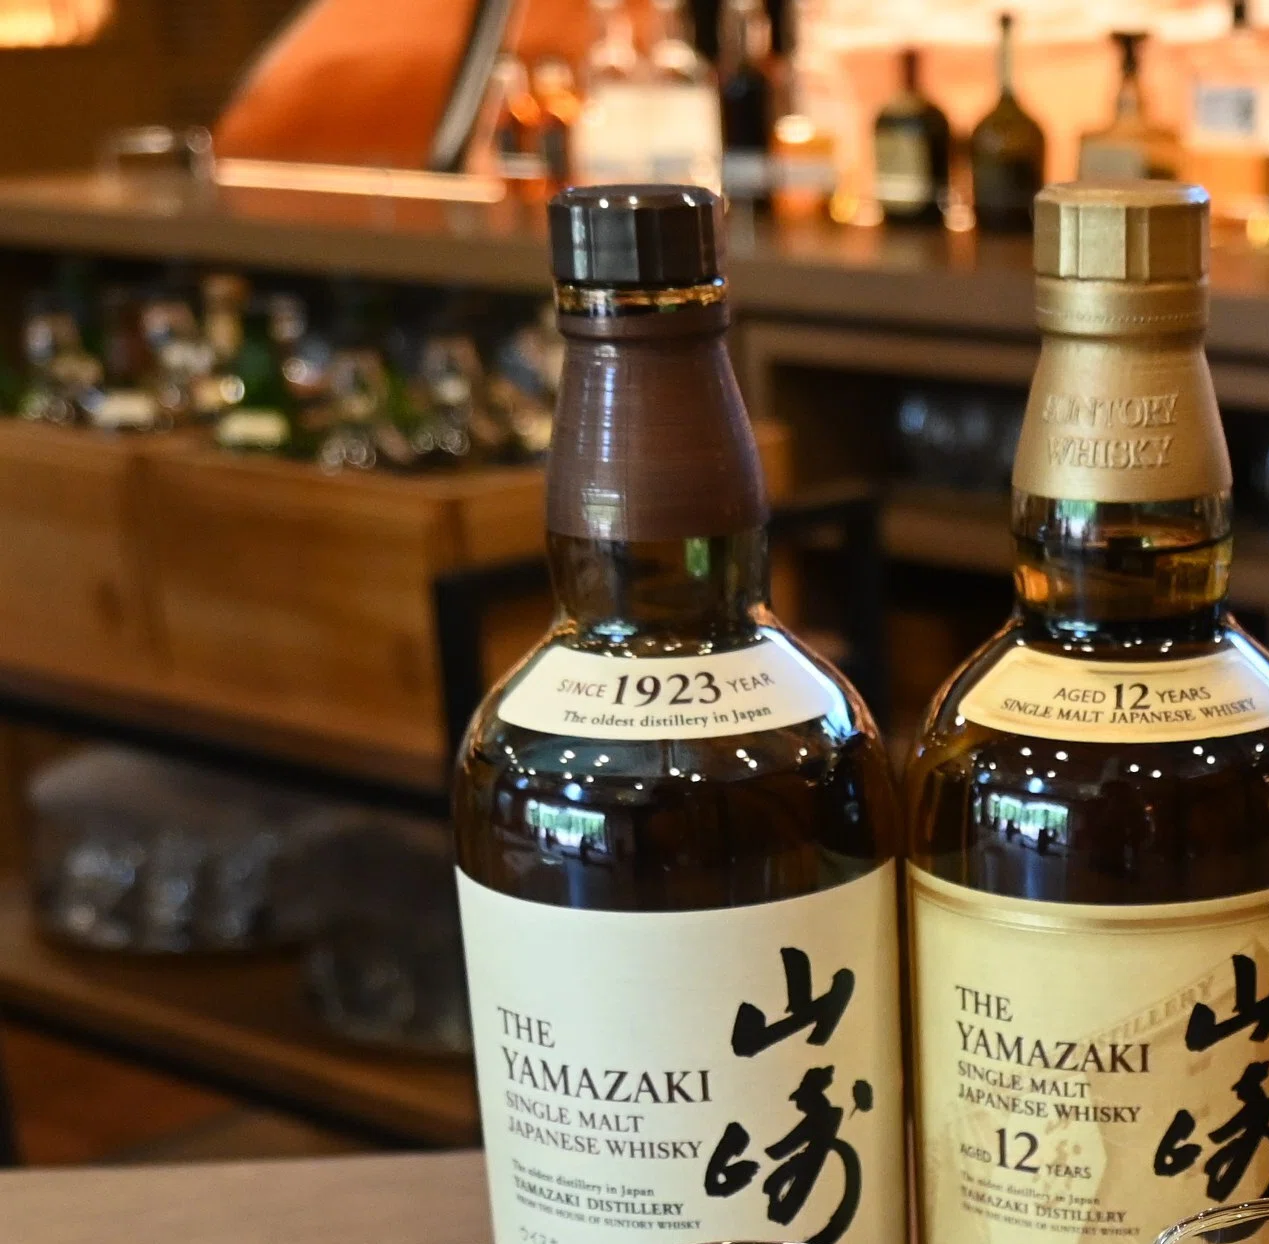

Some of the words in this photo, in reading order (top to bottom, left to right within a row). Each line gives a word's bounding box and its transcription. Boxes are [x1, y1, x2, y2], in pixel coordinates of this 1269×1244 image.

[556, 678, 606, 698] SINCE
[611, 671, 722, 707] 1923
[727, 672, 775, 694] YEAR
[1053, 687, 1106, 704] AGED
[1112, 683, 1151, 710] 12
[1155, 687, 1211, 704] YEARS
[562, 709, 587, 724] The
[589, 711, 634, 727] oldest
[639, 711, 708, 728] distillery
[713, 710, 729, 723] in
[732, 706, 772, 724] Japan
[1000, 698, 1053, 719] SINGLE
[1056, 707, 1104, 724] MALT
[1109, 709, 1197, 724] JAPANESE
[1200, 698, 1256, 719] WHISKY
[955, 985, 1013, 1023] THE
[497, 1006, 555, 1048] THE
[955, 1020, 1150, 1074] YAMAZAKI
[500, 1046, 712, 1103] YAMAZAKI
[957, 1060, 1024, 1092] SINGLE
[1030, 1077, 1091, 1099] MALT
[505, 1090, 572, 1126] SINGLE
[578, 1110, 645, 1134] MALT
[958, 1083, 1048, 1119] JAPANESE
[1054, 1103, 1141, 1124] WHISKY
[507, 1116, 600, 1156] JAPANESE
[605, 1139, 703, 1160] WHISKY
[960, 1143, 992, 1163] AGED
[995, 1127, 1040, 1174] 12
[1046, 1164, 1092, 1180] YEARS
[513, 1175, 580, 1207] YAMAZAKI
[587, 1198, 684, 1216] DISTILLERY
[556, 1174, 602, 1192] distillery
[606, 1184, 617, 1195] in
[621, 1185, 655, 1199] Japan
[960, 1185, 1028, 1214] YAMAZAKI
[1035, 1204, 1127, 1223] DISTILLERY
[1069, 1194, 1100, 1206] Japan
[555, 1206, 586, 1222] HOUSE
[588, 1215, 601, 1225] OF
[604, 1218, 653, 1229] SUNTORY
[657, 1220, 703, 1230] WHISKY
